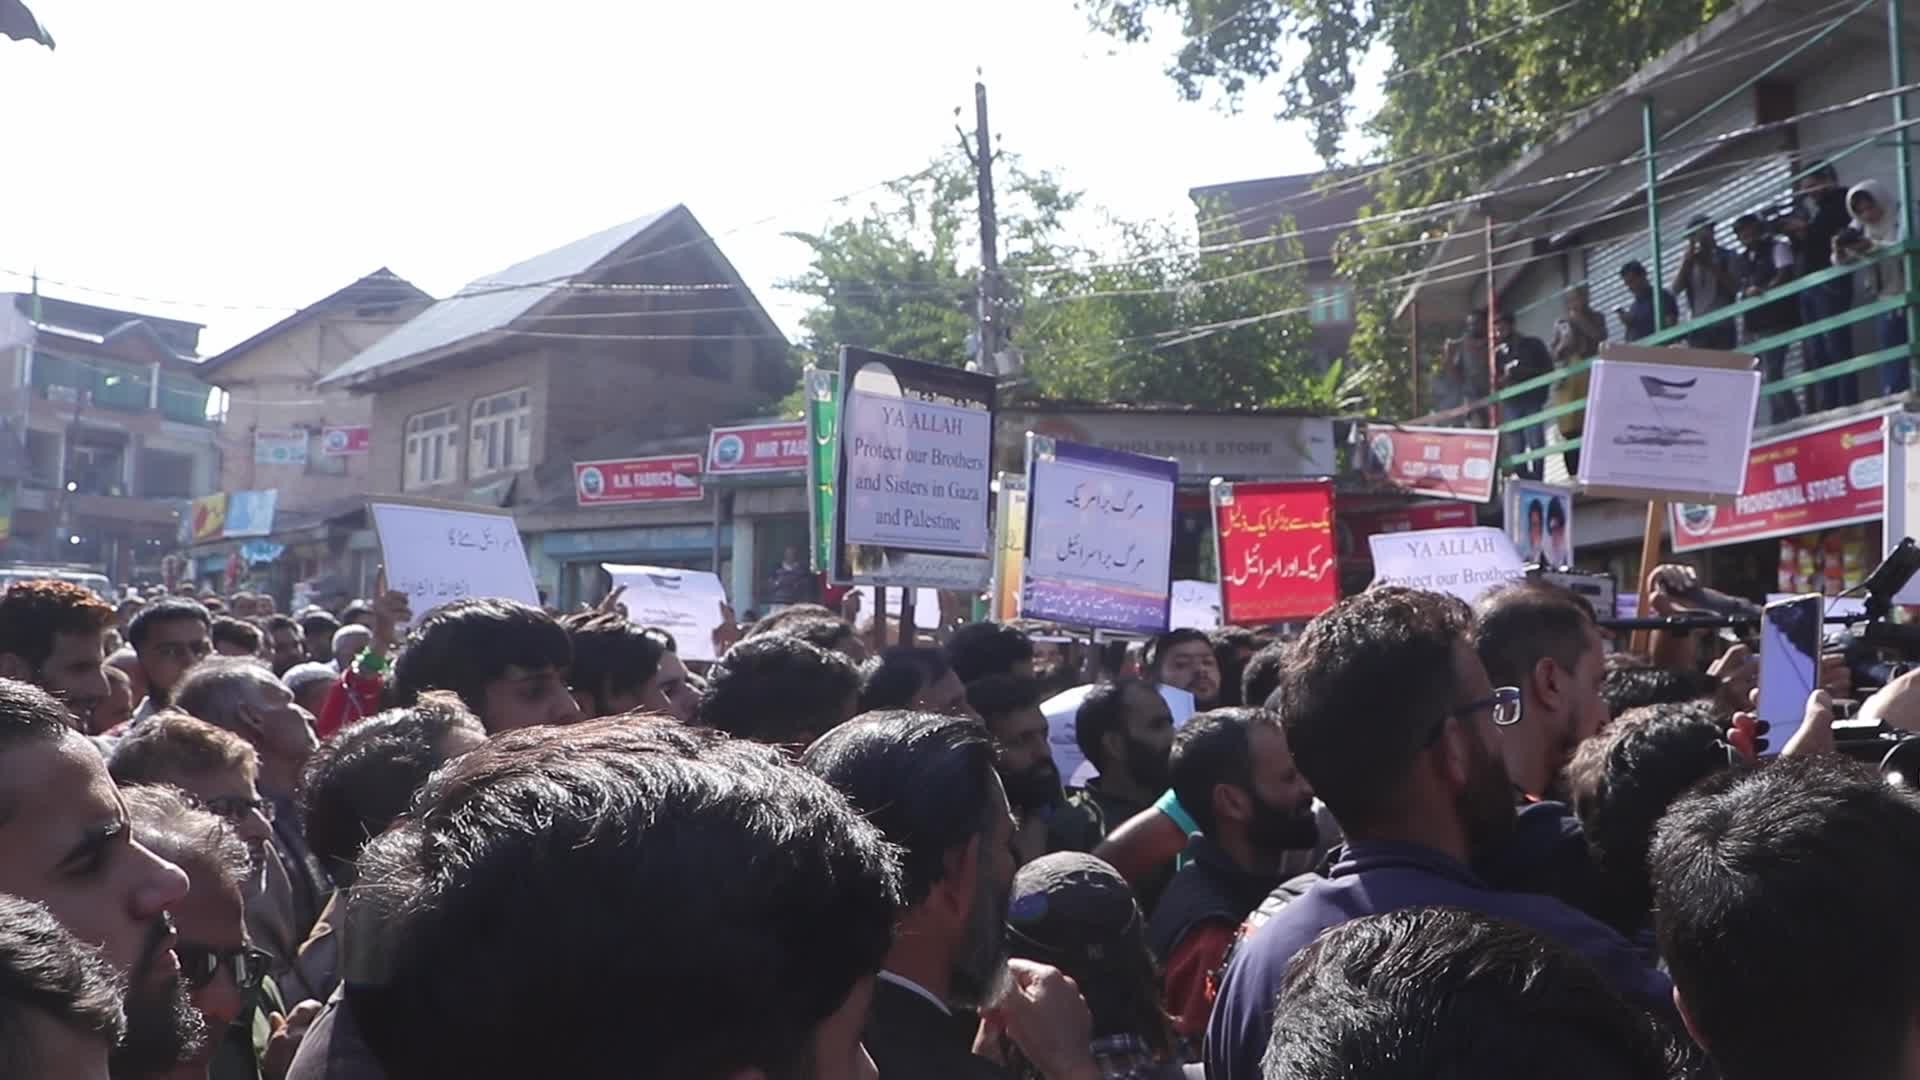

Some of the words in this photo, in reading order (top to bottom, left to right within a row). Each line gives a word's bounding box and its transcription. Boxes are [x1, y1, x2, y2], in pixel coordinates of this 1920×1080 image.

[882, 407, 905, 427] YA
[908, 413, 962, 435] ALLAH
[755, 442, 778, 458] MIR
[854, 437, 902, 461] Protect
[905, 449, 928, 463] our
[931, 448, 983, 470] Brothers
[856, 474, 881, 492] and
[885, 475, 928, 497] Sisters
[932, 480, 945, 498] in
[948, 482, 980, 501] Gaza
[1807, 475, 1847, 503] STORE
[1111, 488, 1144, 521] مرگ
[875, 508, 900, 526] and
[904, 509, 961, 530] Palestine
[1113, 544, 1145, 574] مرگ
[1408, 541, 1433, 558] YA
[1439, 537, 1495, 555] ALLAH
[1436, 574, 1459, 585] our
